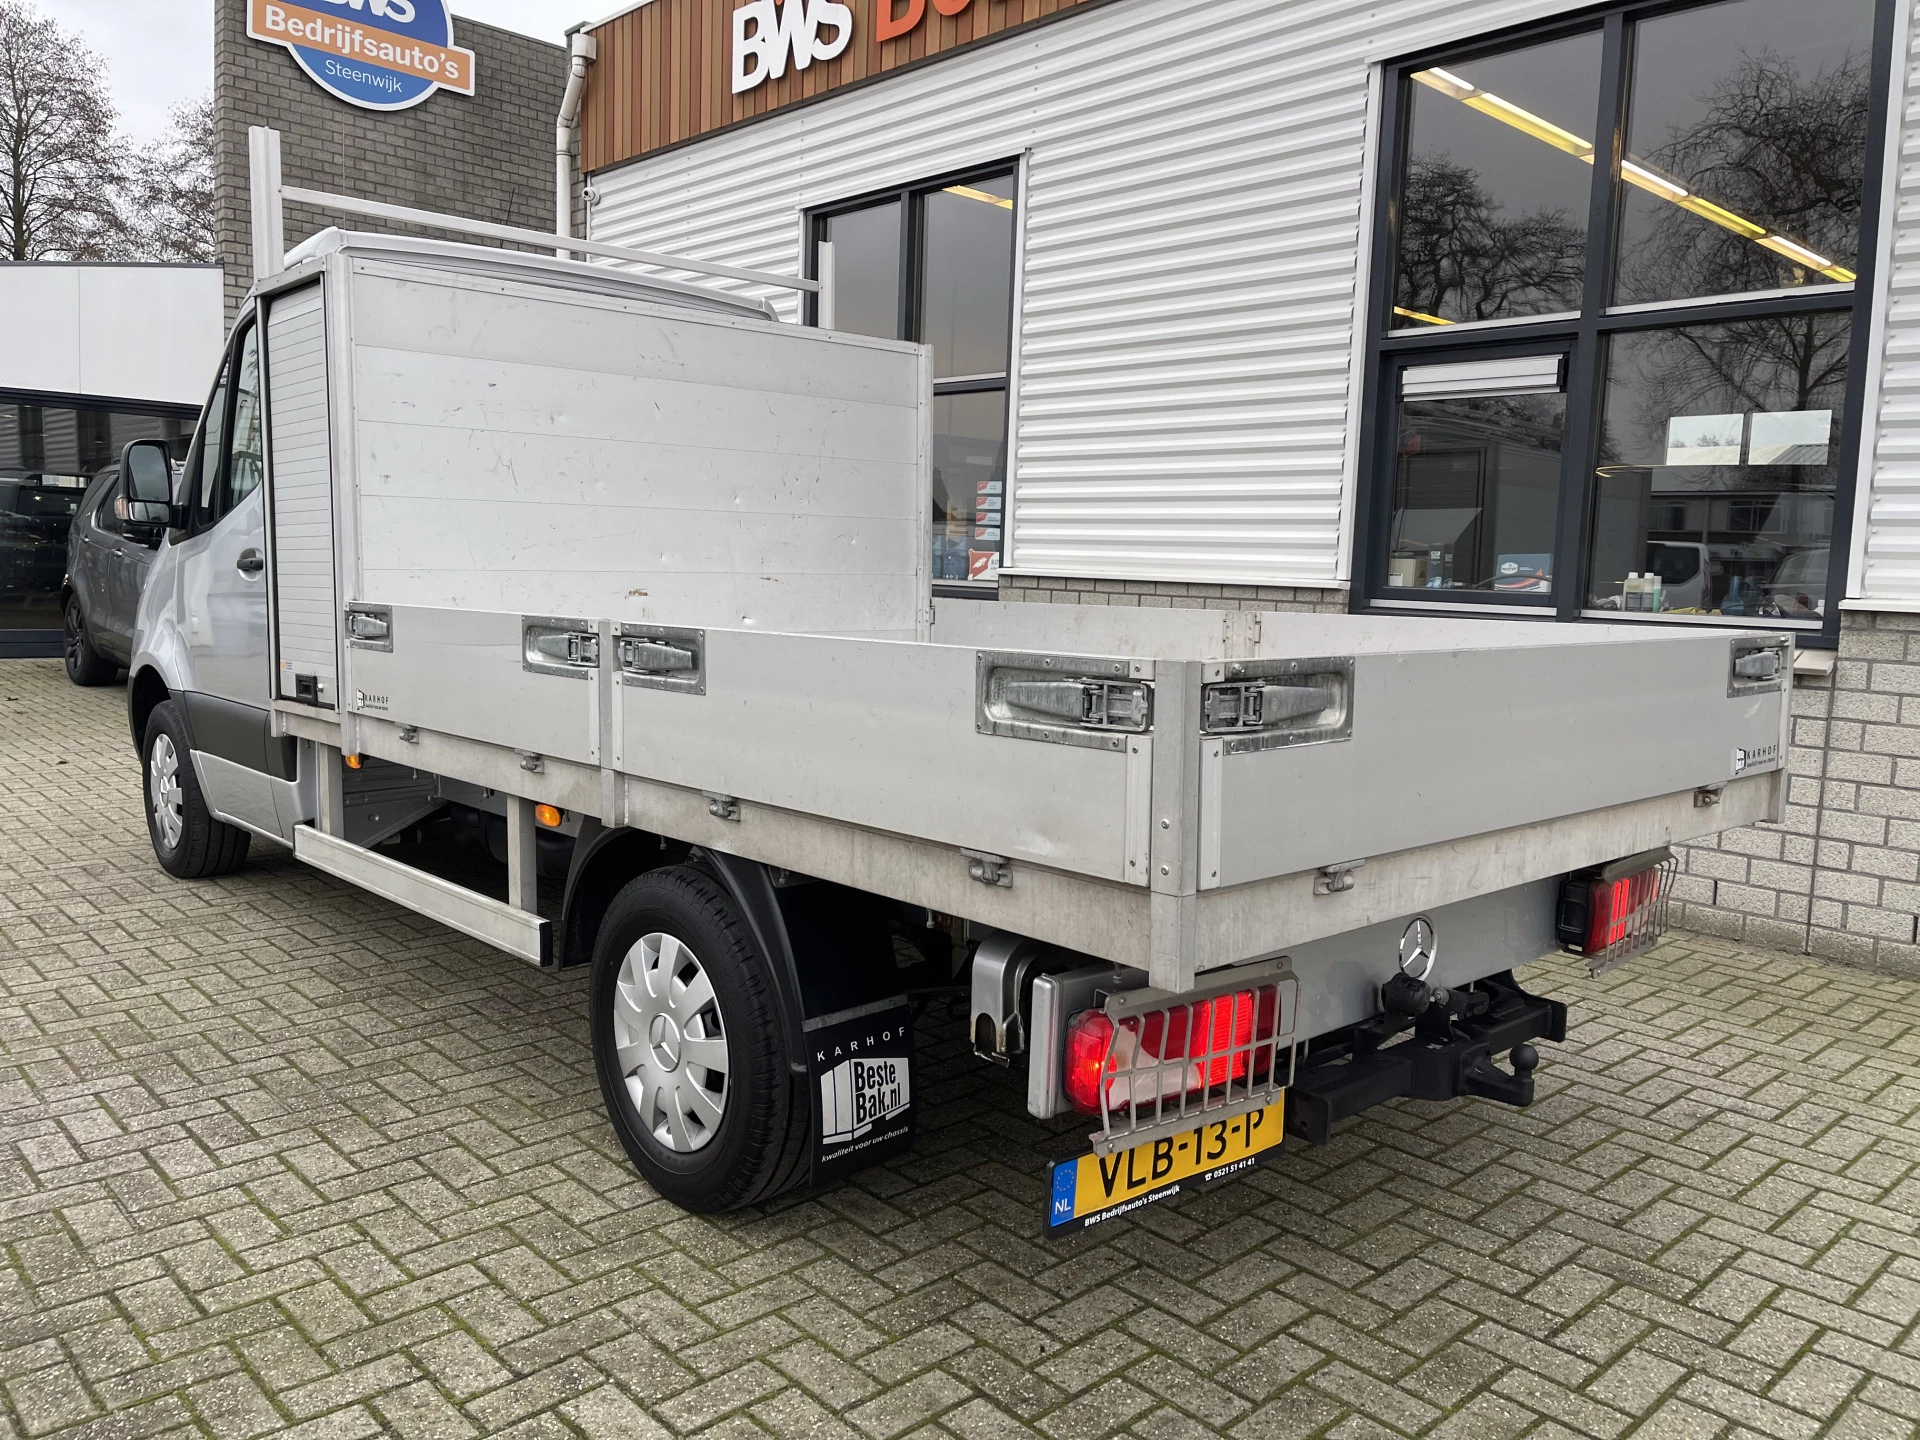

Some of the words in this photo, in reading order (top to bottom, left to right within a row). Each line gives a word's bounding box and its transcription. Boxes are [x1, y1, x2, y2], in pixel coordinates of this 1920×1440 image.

[265, 5, 459, 79] Bedrijfsauto's
[732, 0, 852, 94] BWS
[325, 59, 402, 93] Steenwijk
[365, 694, 389, 704] KARHOF
[1747, 745, 1776, 759] KARHOF
[817, 1026, 905, 1062] KARHOF
[854, 1061, 896, 1092] Beste
[856, 1082, 901, 1124] Bak.nl
[821, 1144, 854, 1163] kwaliteit
[855, 1139, 872, 1151] voor
[872, 1135, 884, 1144] uw
[884, 1125, 909, 1141] chassis
[1099, 1109, 1264, 1198] VLB-13-P
[1213, 1166, 1229, 1178] 0521
[1230, 1163, 1238, 1173] 51
[1238, 1160, 1246, 1169] 41
[1247, 1157, 1255, 1165] 41
[1055, 1197, 1072, 1215] NL
[1084, 1213, 1101, 1227] BWS
[1101, 1197, 1148, 1221] Bedrijfsauto's
[1148, 1184, 1181, 1203] Steenwijk
